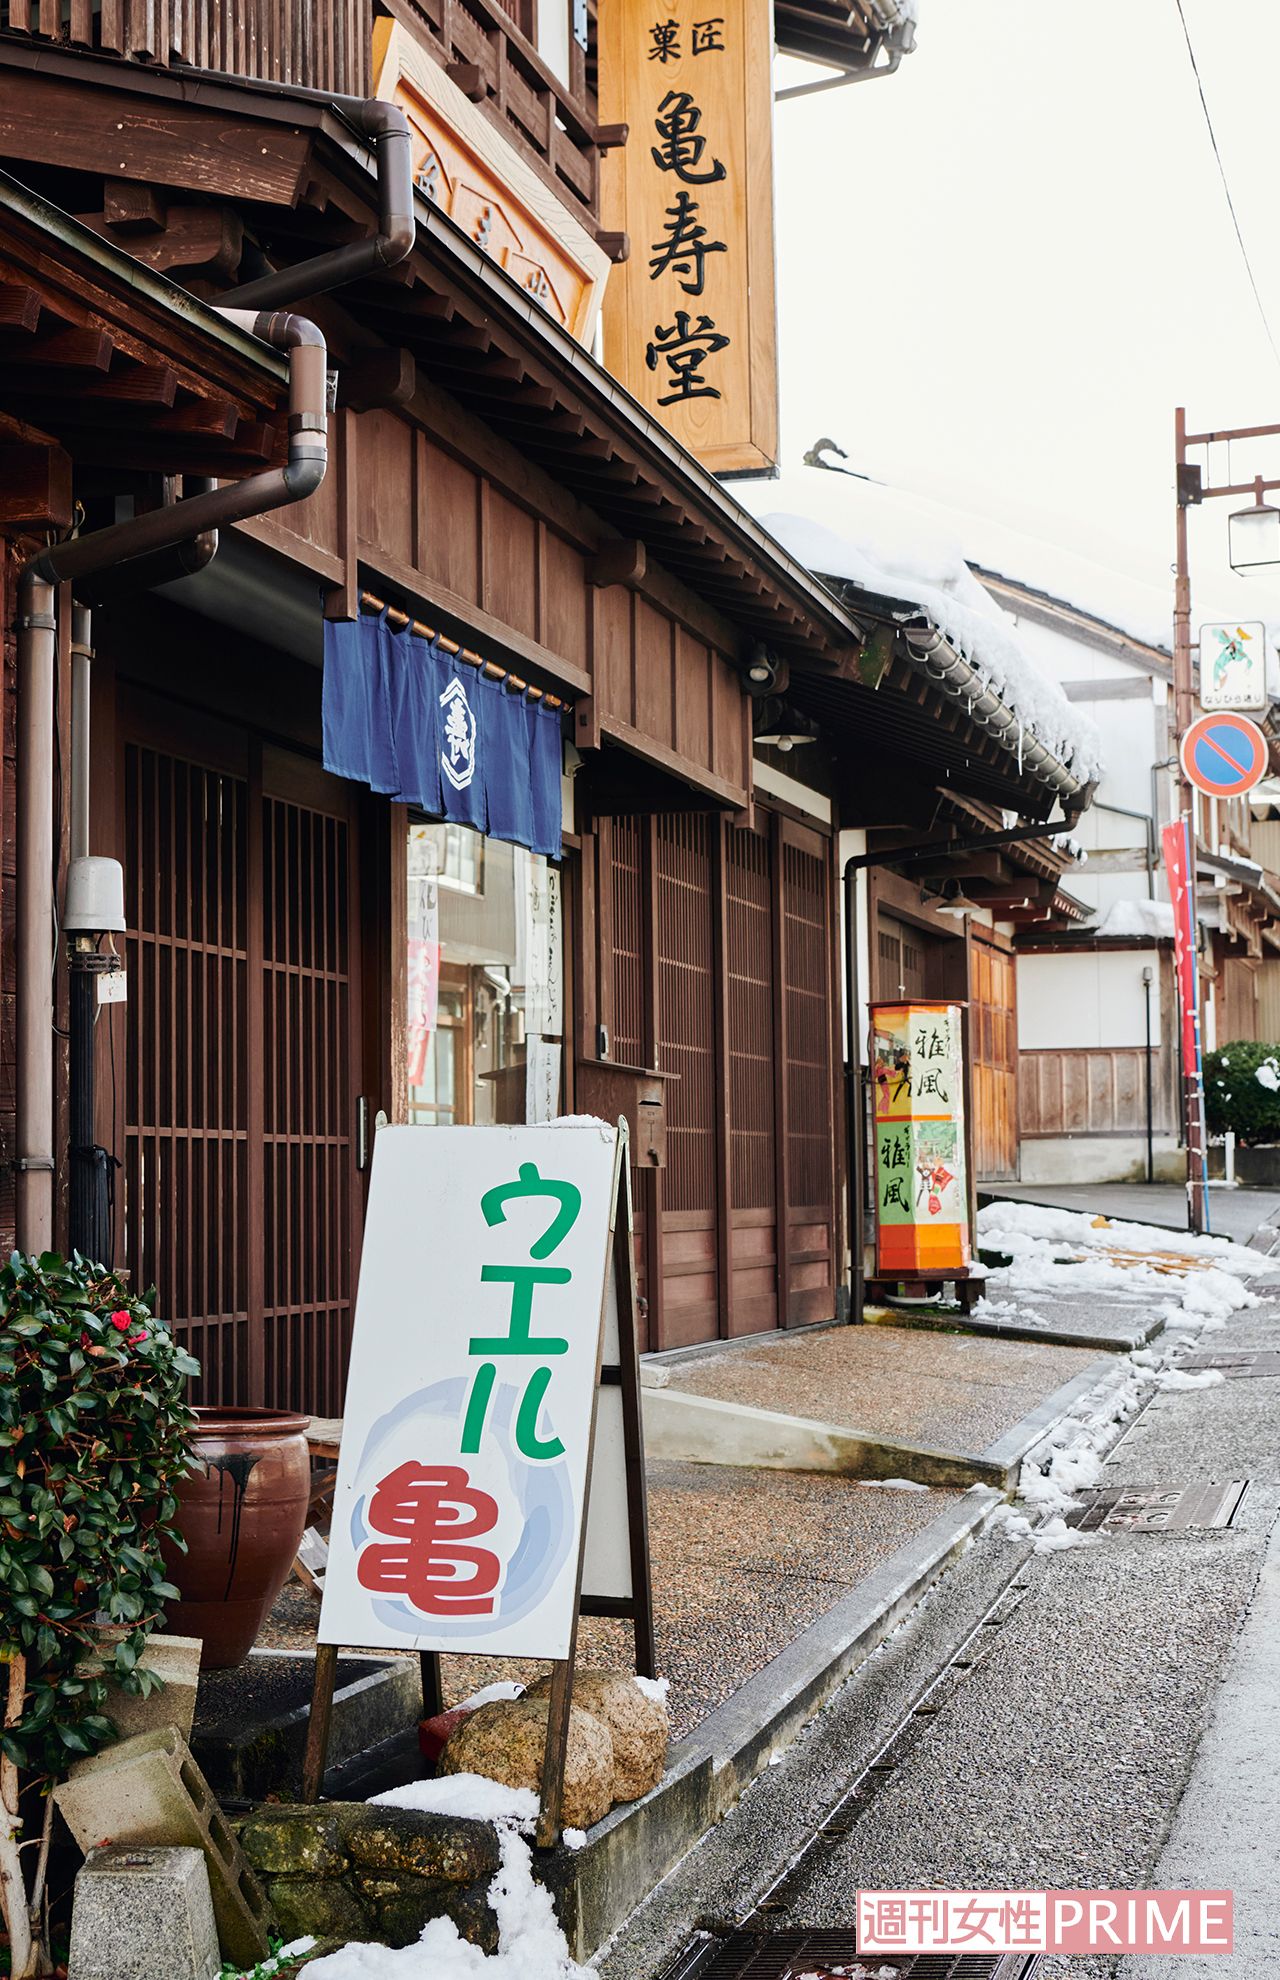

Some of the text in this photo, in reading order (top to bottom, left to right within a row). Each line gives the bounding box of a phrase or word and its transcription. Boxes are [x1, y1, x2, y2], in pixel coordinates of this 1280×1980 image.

[647, 17, 726, 64] 菓匠
[645, 90, 732, 407] 亀寿堂
[914, 1027, 949, 1104] 雅風
[881, 1134, 910, 1213] 雅風
[356, 1459, 501, 1616] 亀
